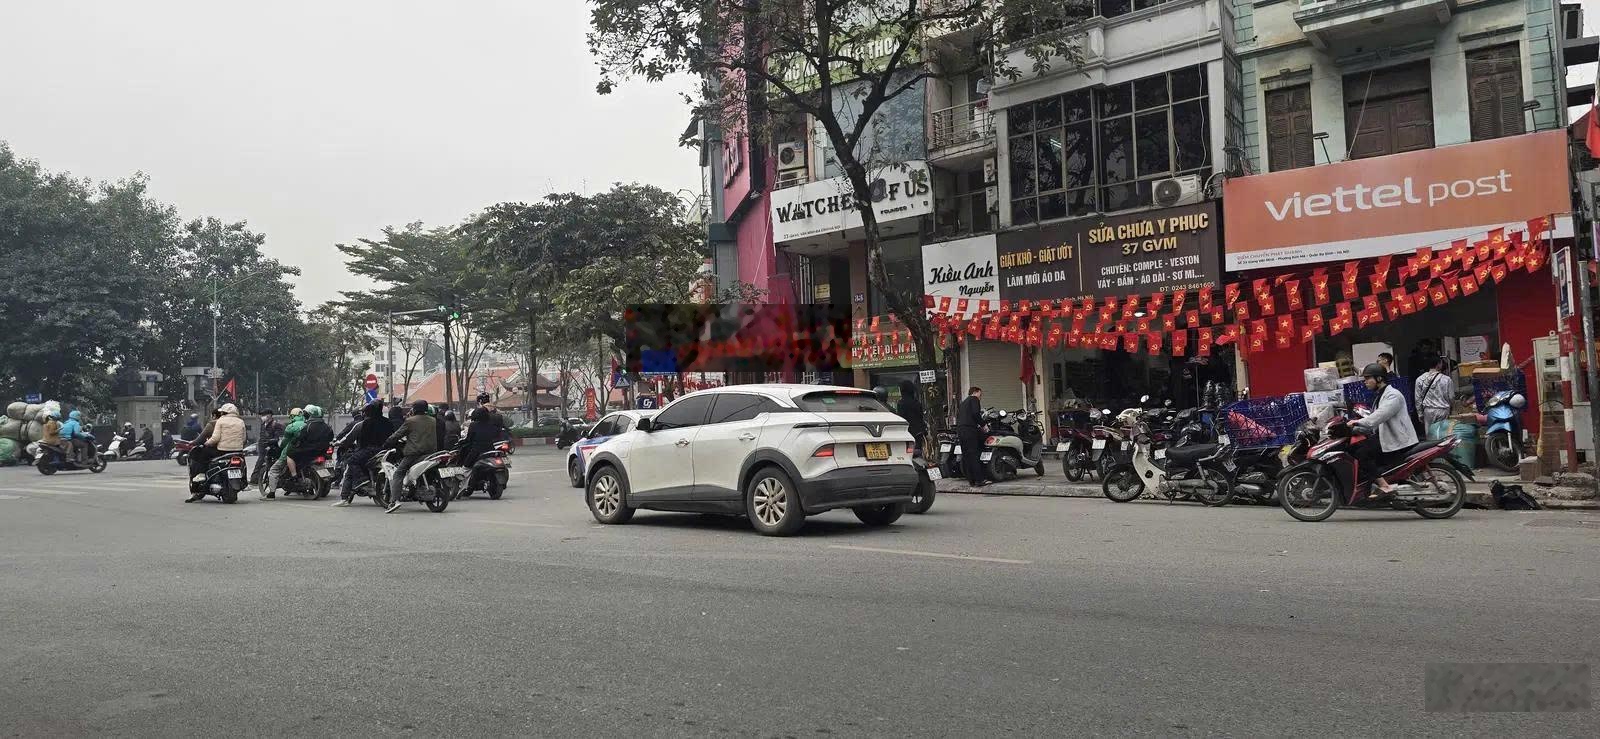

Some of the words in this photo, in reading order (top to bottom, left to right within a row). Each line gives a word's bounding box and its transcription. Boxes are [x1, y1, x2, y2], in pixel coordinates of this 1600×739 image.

[1264, 177, 1421, 222] viettel
[1428, 169, 1512, 207] post
[776, 193, 860, 223] WATCHE
[1088, 222, 1115, 243] SỬA
[1157, 218, 1167, 234] Y
[1169, 212, 1209, 234] PHỤC
[1016, 249, 1032, 265] KHÔ
[1056, 242, 1073, 260] ƯỚT
[1121, 242, 1139, 255] 37
[1142, 237, 1177, 252] GVM
[928, 264, 962, 285] Kiều
[963, 260, 994, 280] Anh
[1101, 262, 1132, 276] CHUYÊN:
[1133, 259, 1163, 272] COMPLE
[1170, 254, 1200, 267] VESTON
[1006, 275, 1023, 287] LÀM
[1152, 271, 1165, 283] DÀI
[958, 282, 994, 297] Nguyễn
